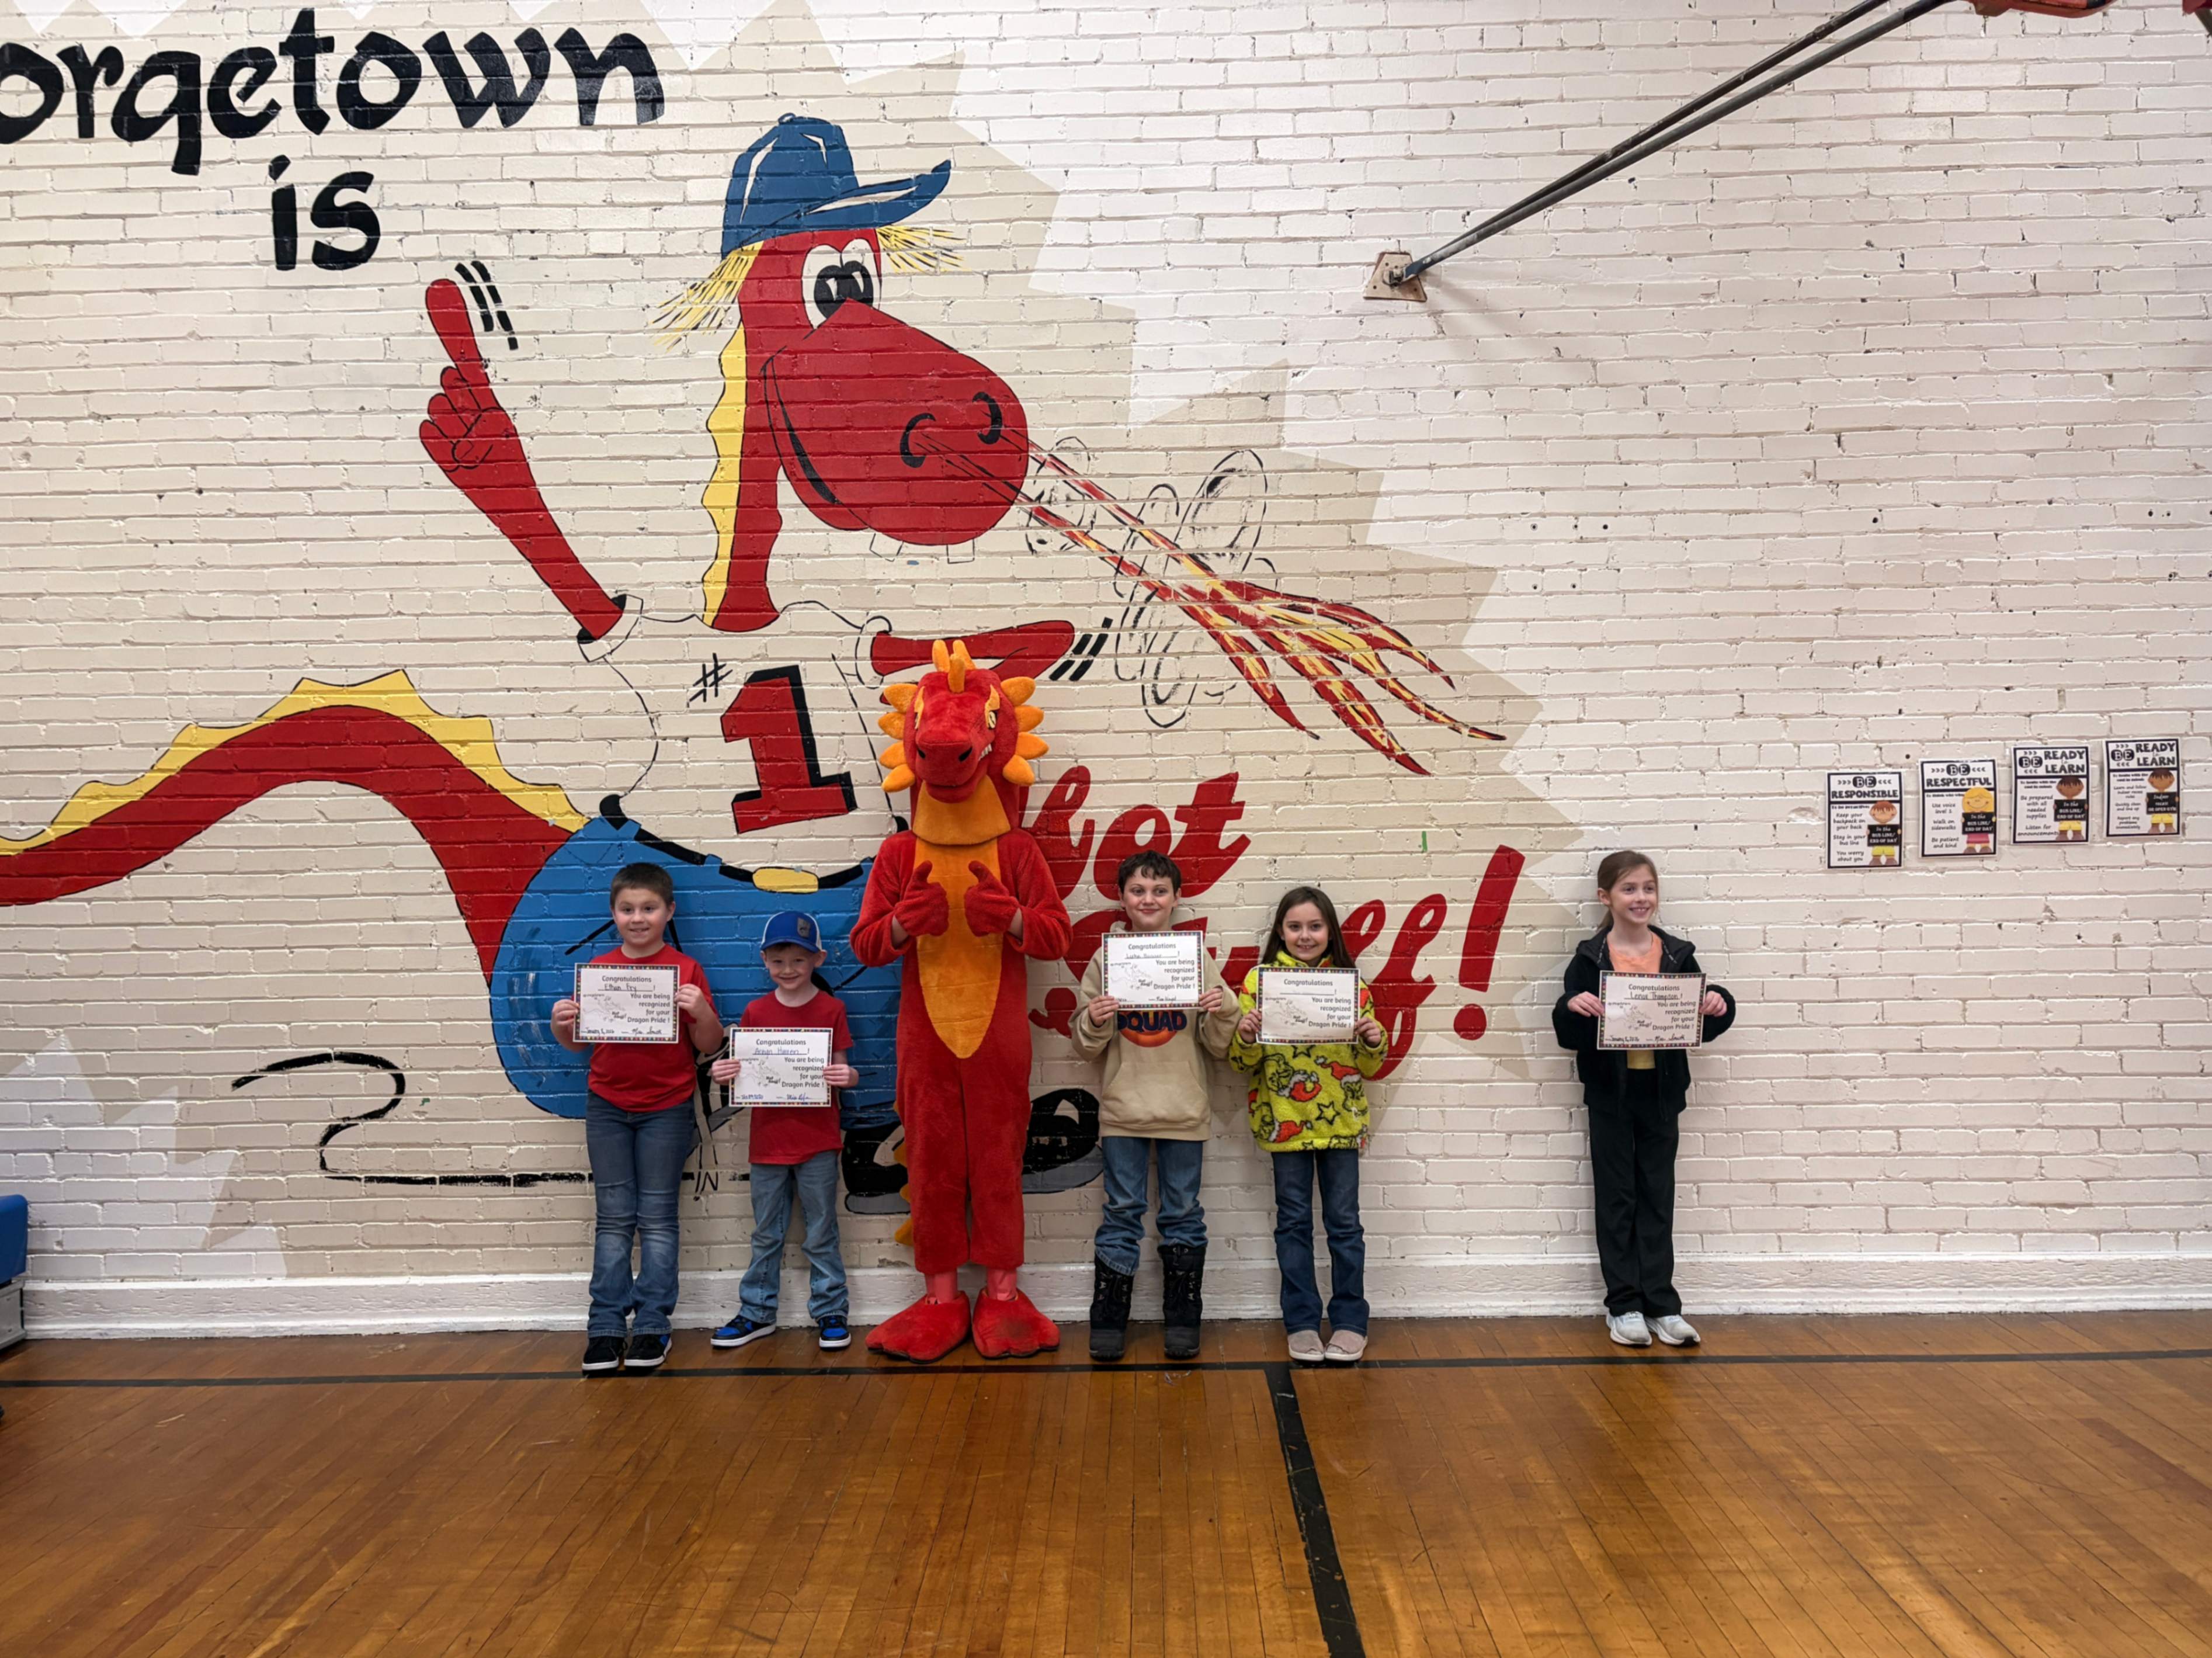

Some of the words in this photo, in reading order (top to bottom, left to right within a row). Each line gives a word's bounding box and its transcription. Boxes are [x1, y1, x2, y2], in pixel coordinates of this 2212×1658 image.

[268, 154, 380, 270] is
[2135, 743, 2175, 752] READY
[2044, 750, 2085, 759] READY
[2112, 750, 2134, 761] BE
[2020, 757, 2041, 768] BE
[2137, 757, 2175, 766] LEARN
[1947, 764, 1969, 775] BE
[2045, 764, 2085, 773] LEARN
[1854, 776, 1876, 788] BE
[1926, 777, 1992, 787] RESPECTFUL
[1832, 790, 1898, 799] RESPONSIBLE
